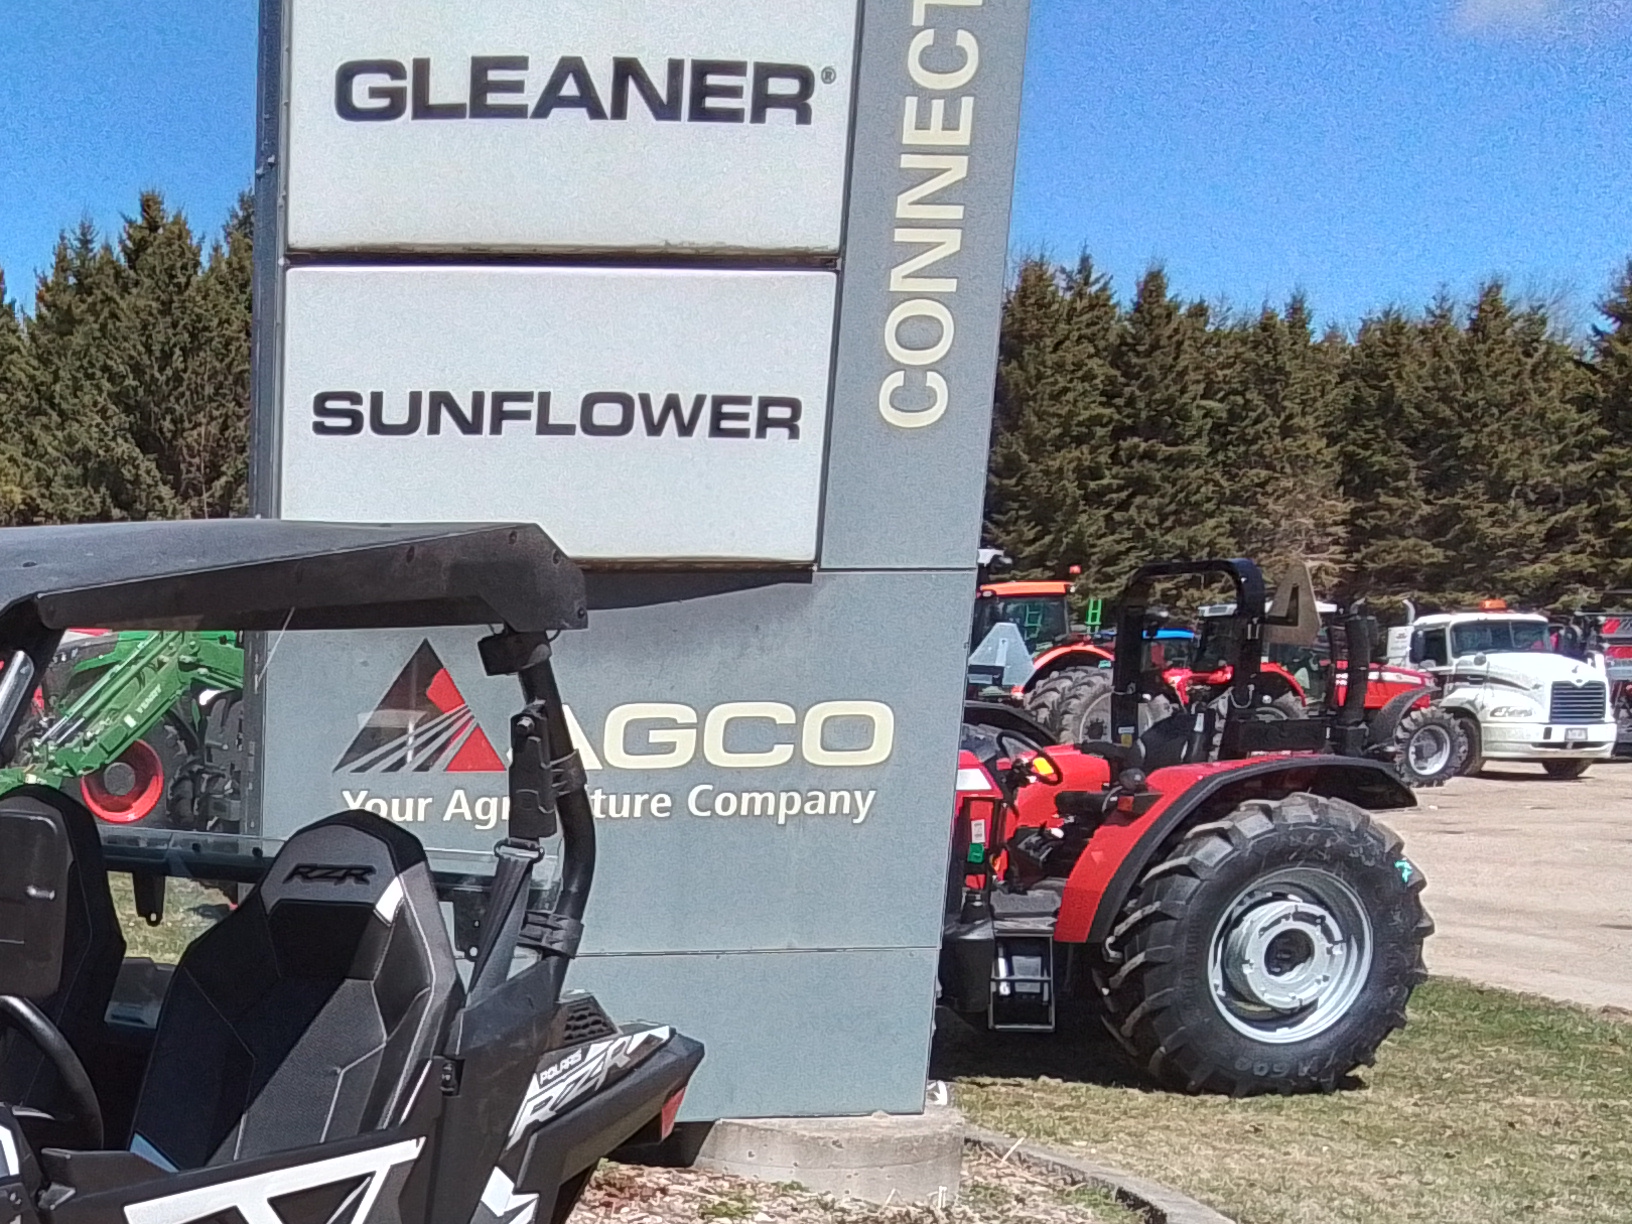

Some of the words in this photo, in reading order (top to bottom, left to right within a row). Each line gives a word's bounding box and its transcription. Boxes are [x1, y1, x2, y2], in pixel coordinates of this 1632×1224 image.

[311, 389, 803, 441] SUNFLOWER
[341, 789, 433, 822] Your
[687, 783, 877, 825] Company
[539, 1047, 583, 1086] POLARIS
